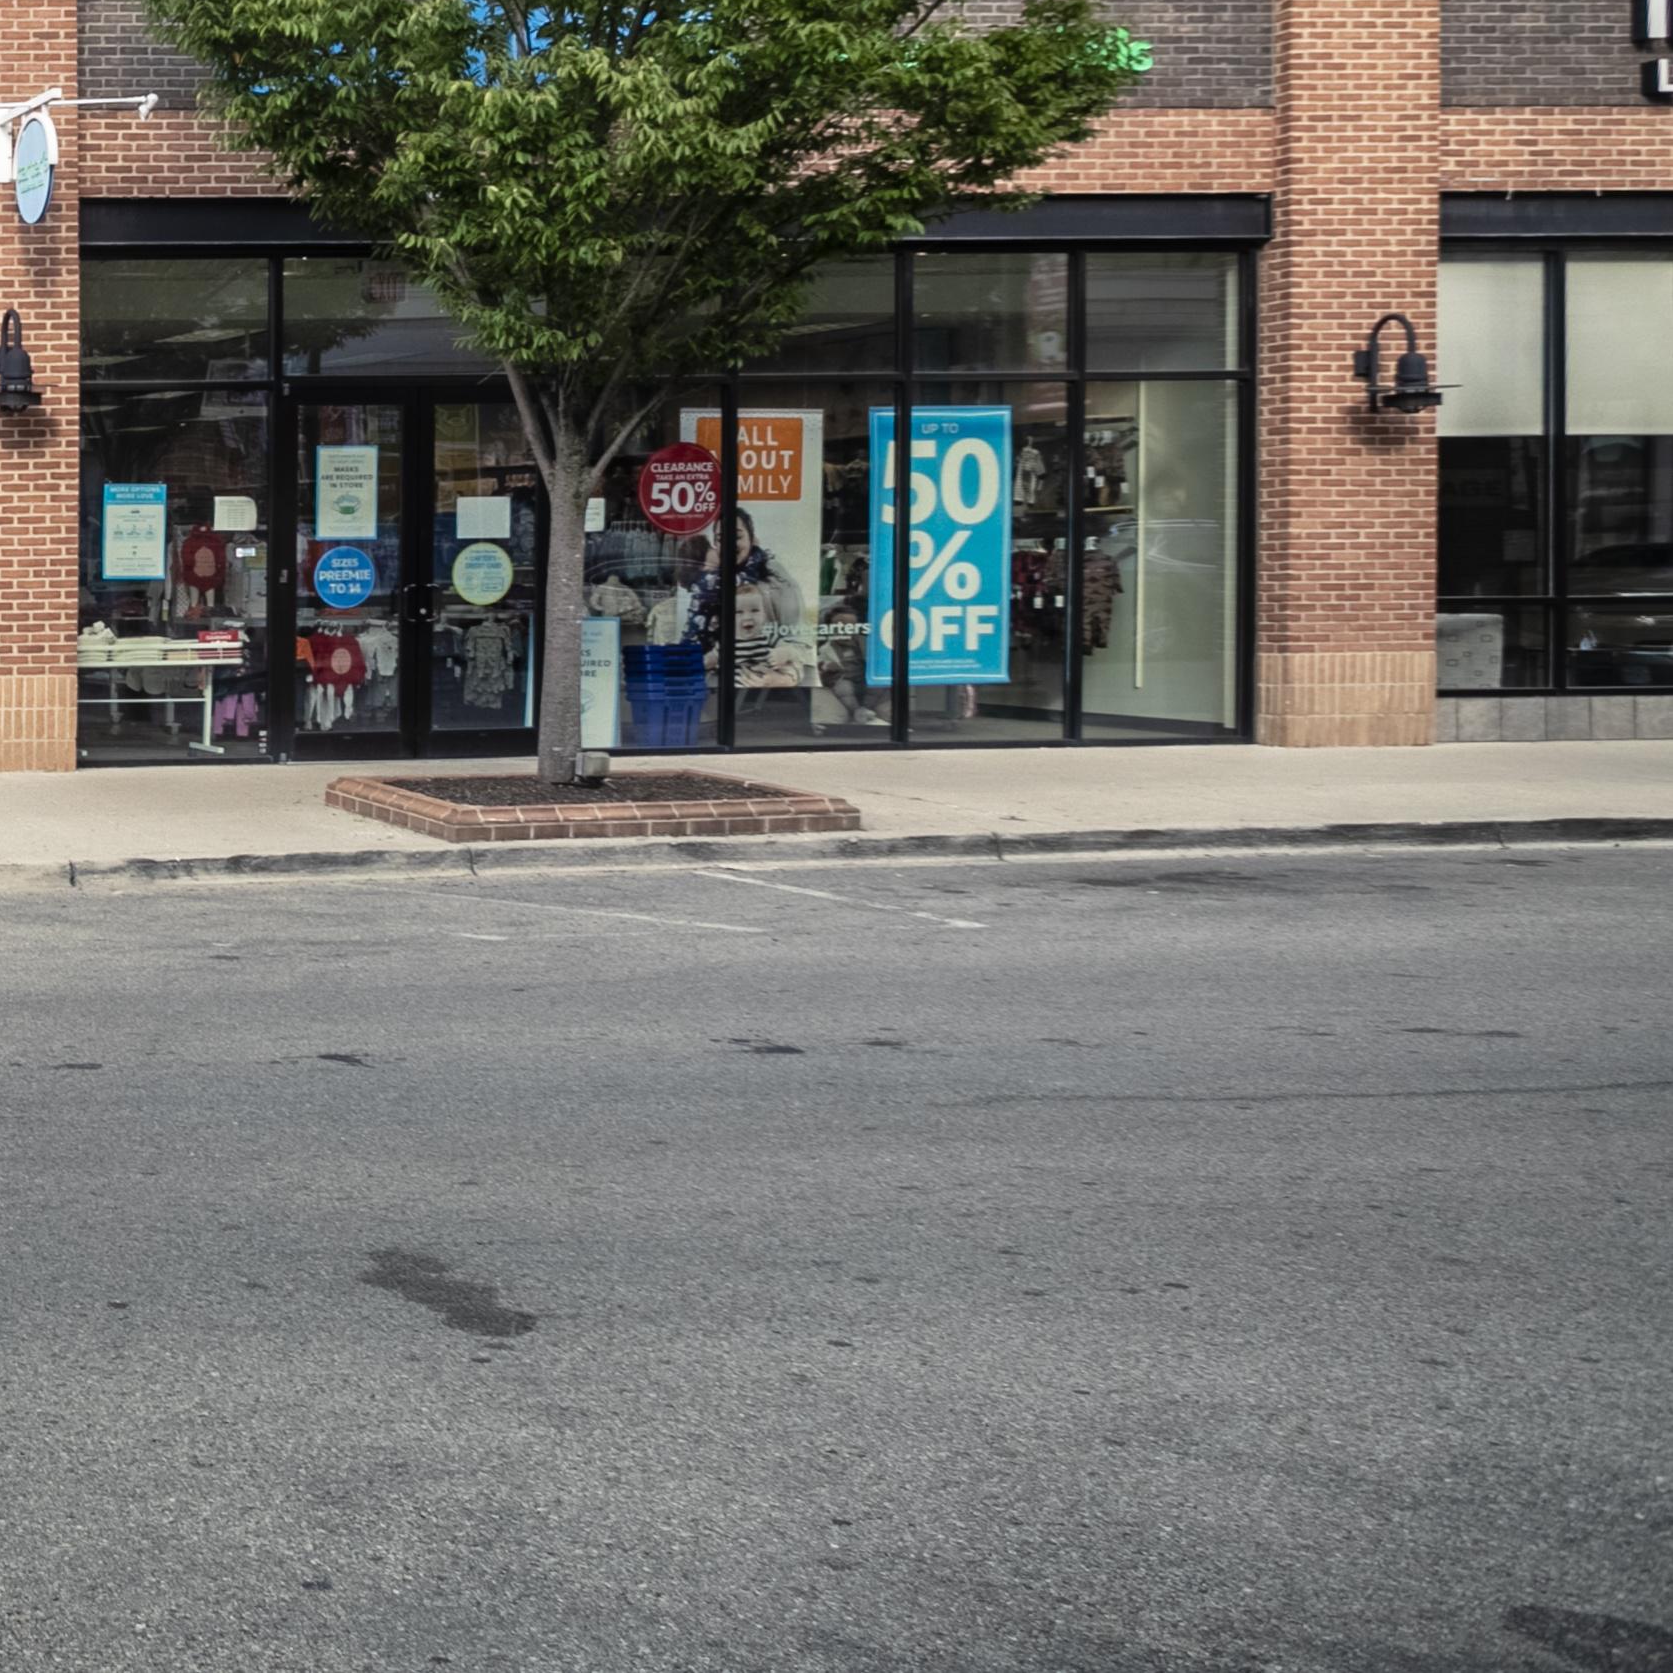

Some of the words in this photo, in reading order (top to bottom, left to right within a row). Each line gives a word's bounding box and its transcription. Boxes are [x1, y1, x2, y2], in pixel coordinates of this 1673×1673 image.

[737, 425, 779, 447] ALL
[921, 423, 940, 434] UP
[942, 423, 959, 434] TO
[649, 462, 714, 473] CLEARANCE
[737, 475, 793, 495] MILY
[881, 437, 1000, 525] 50
[650, 481, 716, 514] 50%
[694, 502, 716, 513] OFF
[330, 557, 359, 567] SIZES
[909, 529, 982, 601] %
[318, 569, 371, 581] PREEMIE
[328, 583, 346, 594] TO
[879, 605, 999, 652] OFF
